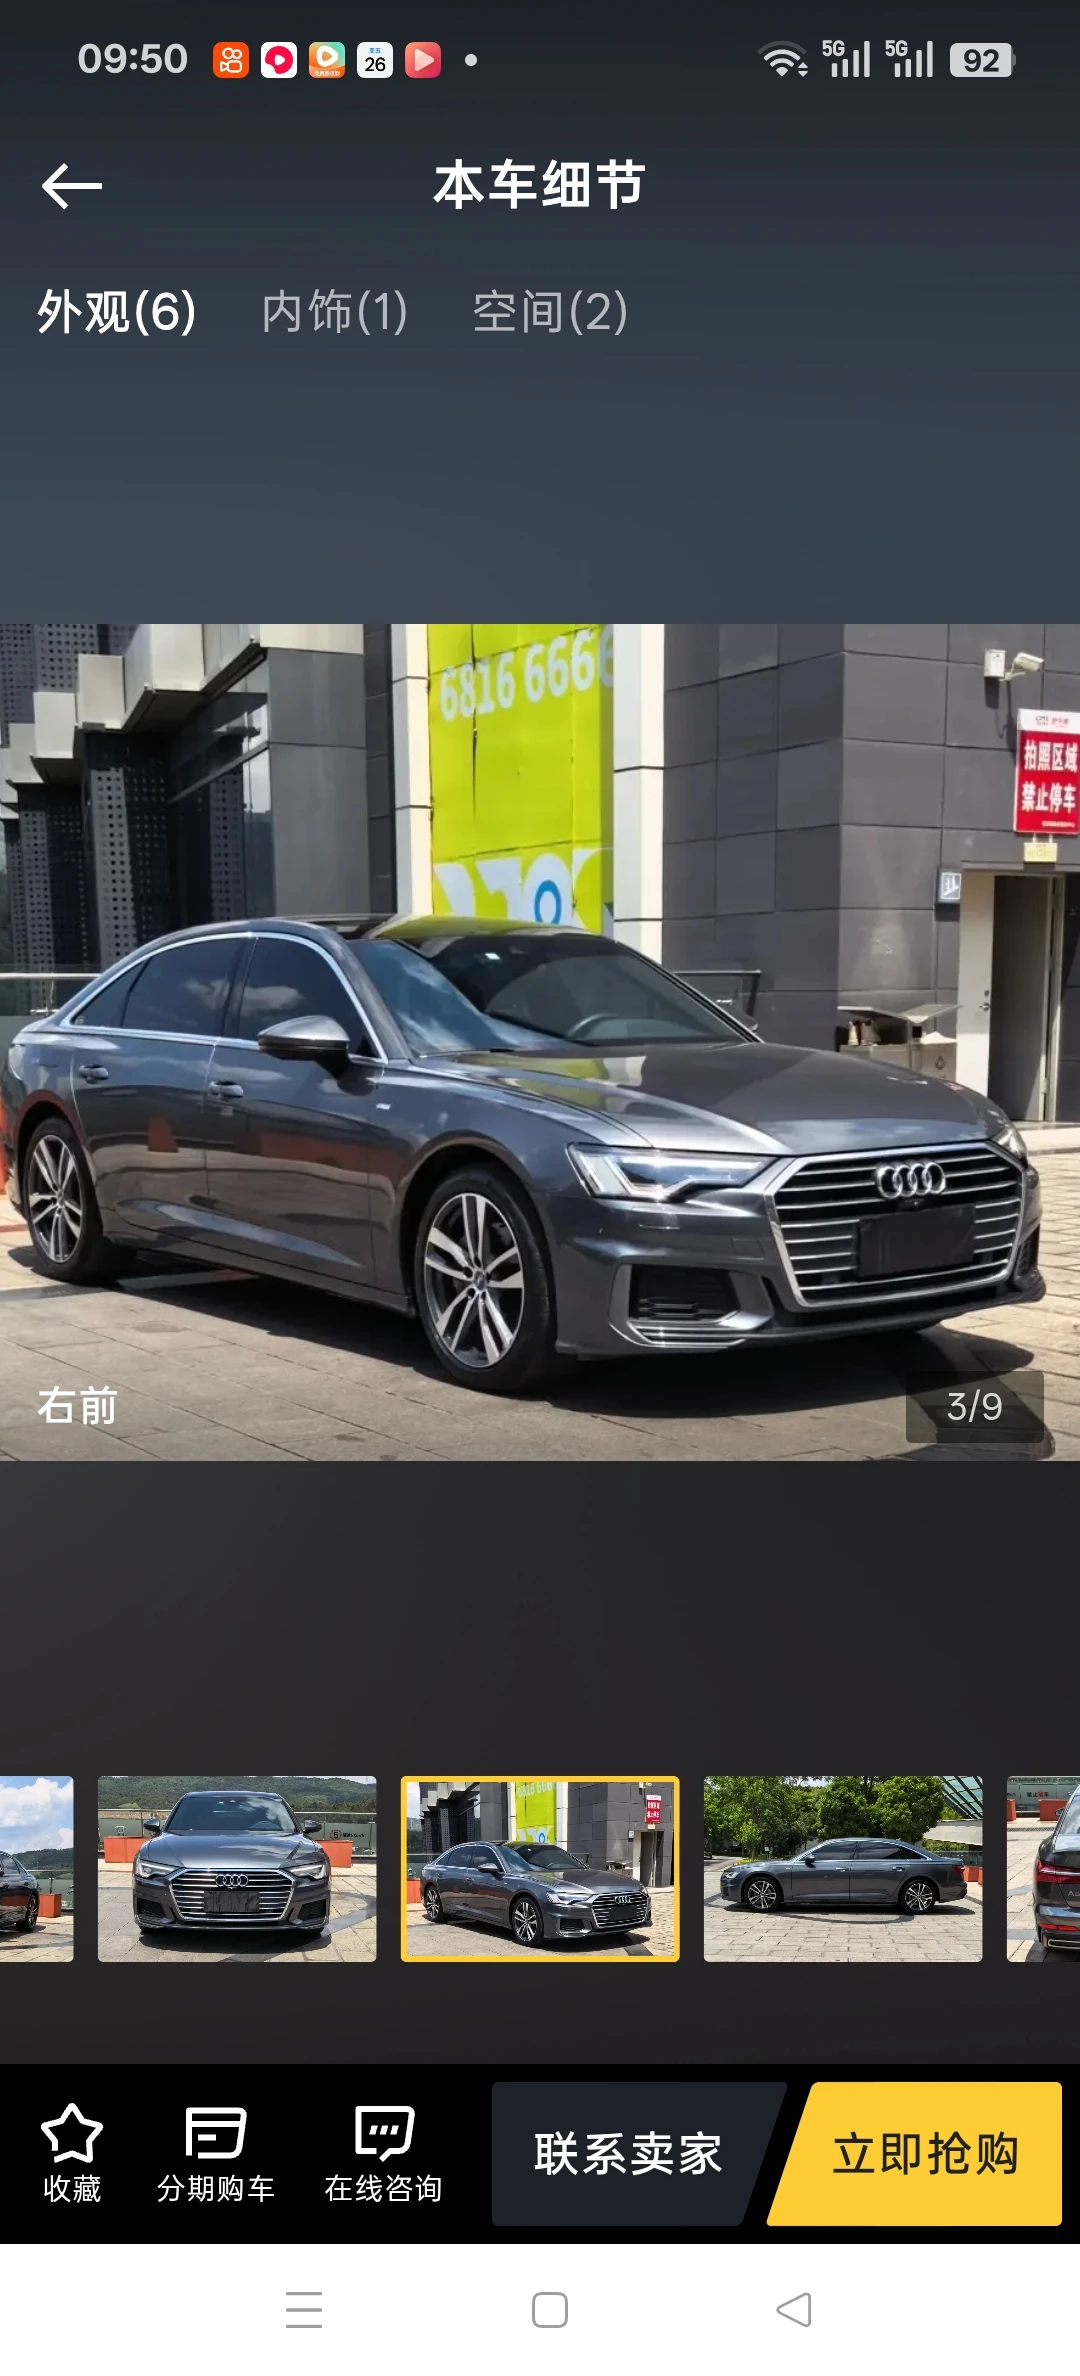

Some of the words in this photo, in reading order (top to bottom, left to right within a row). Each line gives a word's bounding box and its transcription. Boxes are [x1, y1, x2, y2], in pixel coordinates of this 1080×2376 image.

[78, 43, 188, 74] 09:50
[364, 56, 386, 72] 26
[822, 39, 846, 57] 5G
[885, 39, 909, 57] 5G
[963, 48, 1000, 73] 92
[432, 157, 646, 210] 本车细节
[36, 288, 197, 337] 外观(6)
[262, 288, 408, 337] 内饰(1)
[472, 288, 628, 337] 空间(2)
[440, 652, 516, 722] 6816
[1024, 739, 1078, 773] 拍照区域
[1022, 781, 1077, 814] 禁止停车
[533, 2130, 723, 2176] 联系卖家
[832, 2131, 1018, 2176] 立即抢购
[43, 2174, 102, 2204] 收藏
[157, 2173, 275, 2203] 分期购车
[324, 2173, 442, 2203] 在线咨询
